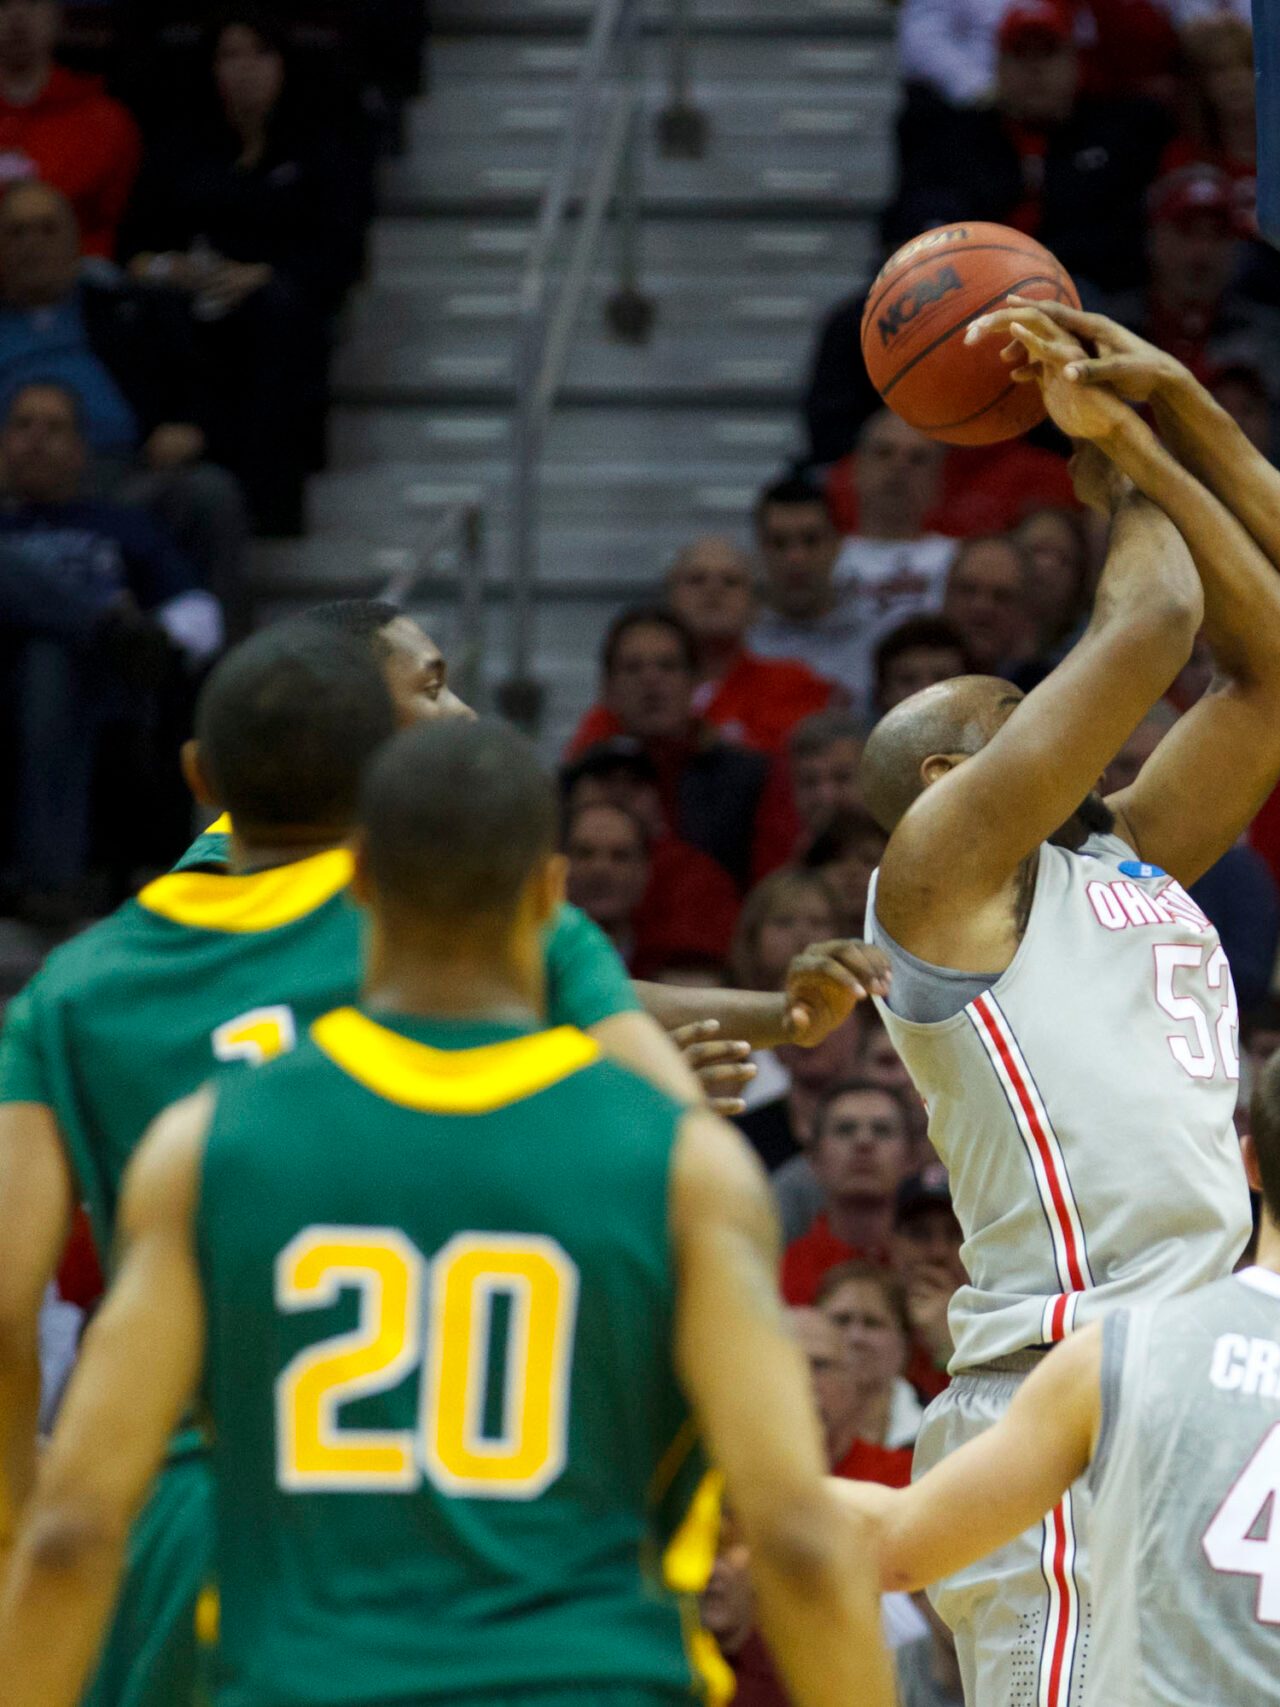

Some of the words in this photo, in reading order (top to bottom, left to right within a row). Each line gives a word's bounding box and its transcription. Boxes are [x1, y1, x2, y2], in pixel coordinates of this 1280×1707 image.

[878, 265, 965, 347] NCAA
[1152, 943, 1239, 1080] 52
[274, 1222, 580, 1502] 20
